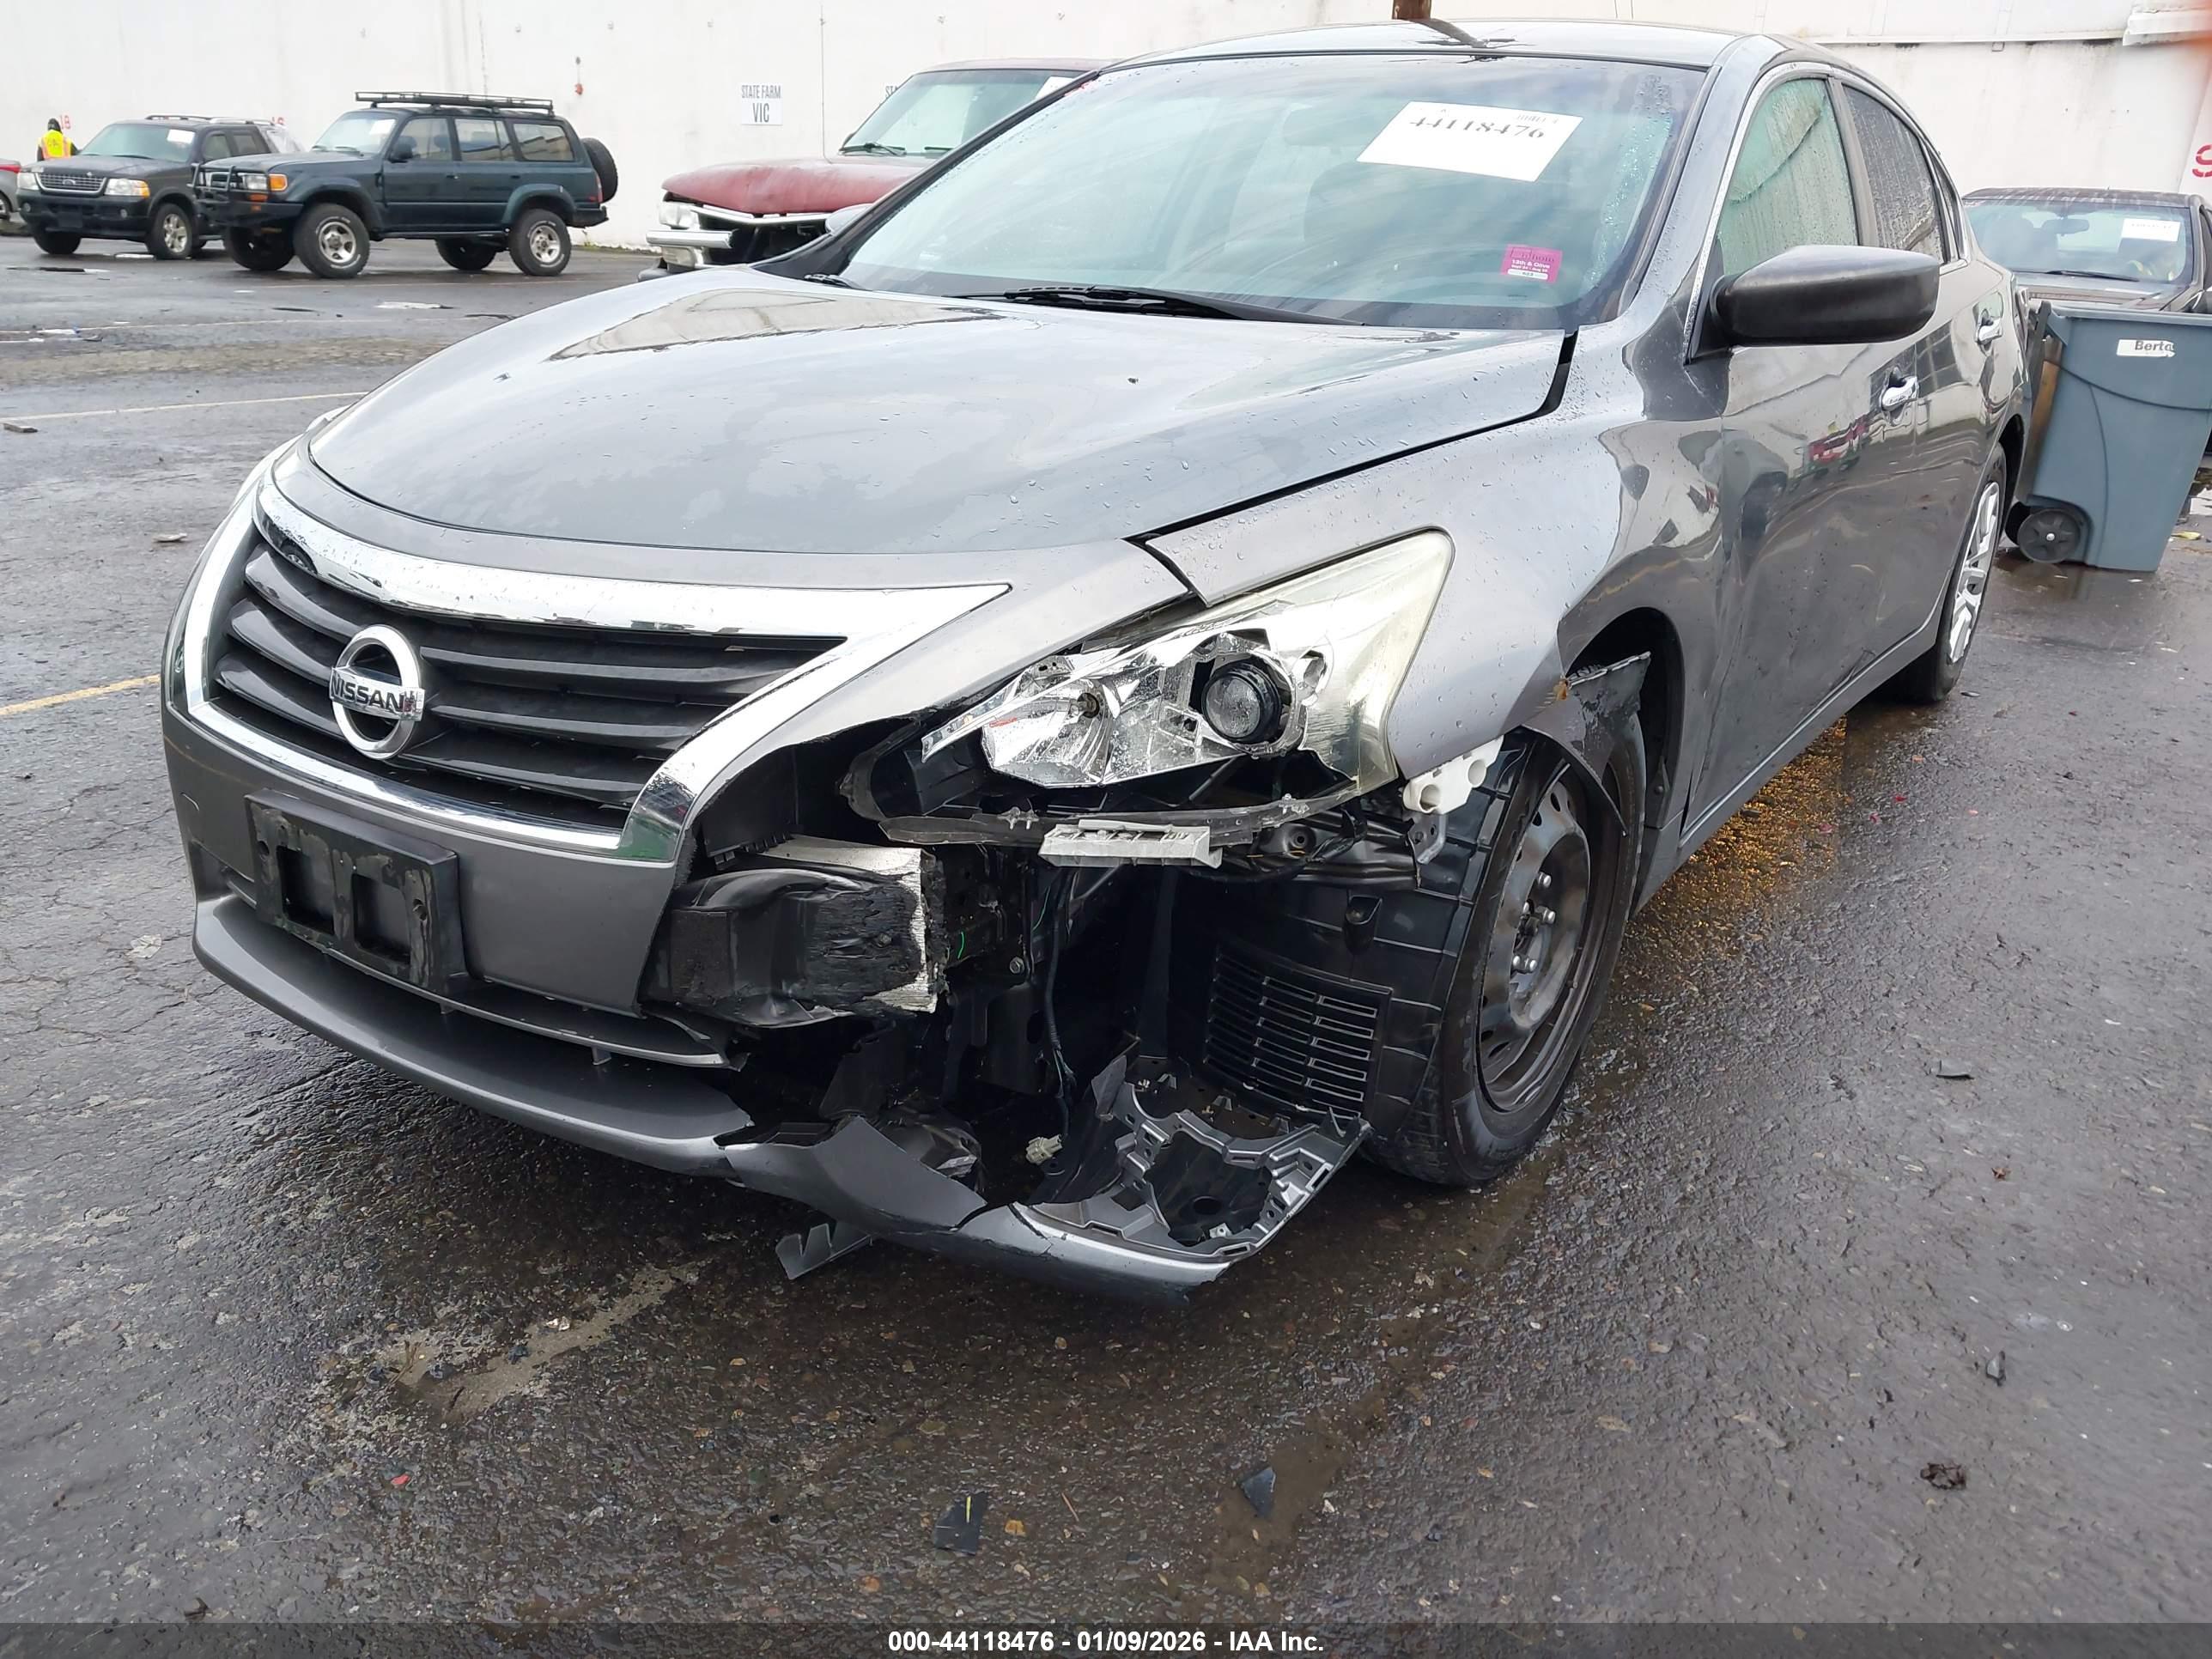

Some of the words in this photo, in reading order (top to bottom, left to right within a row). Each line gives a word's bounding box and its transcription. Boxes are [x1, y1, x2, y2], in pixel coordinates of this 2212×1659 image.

[741, 84, 760, 99] STATE
[761, 84, 781, 99] FARM
[752, 102, 769, 123] VIC
[1409, 117, 1545, 138] 44118476
[330, 674, 404, 713] NISSAN
